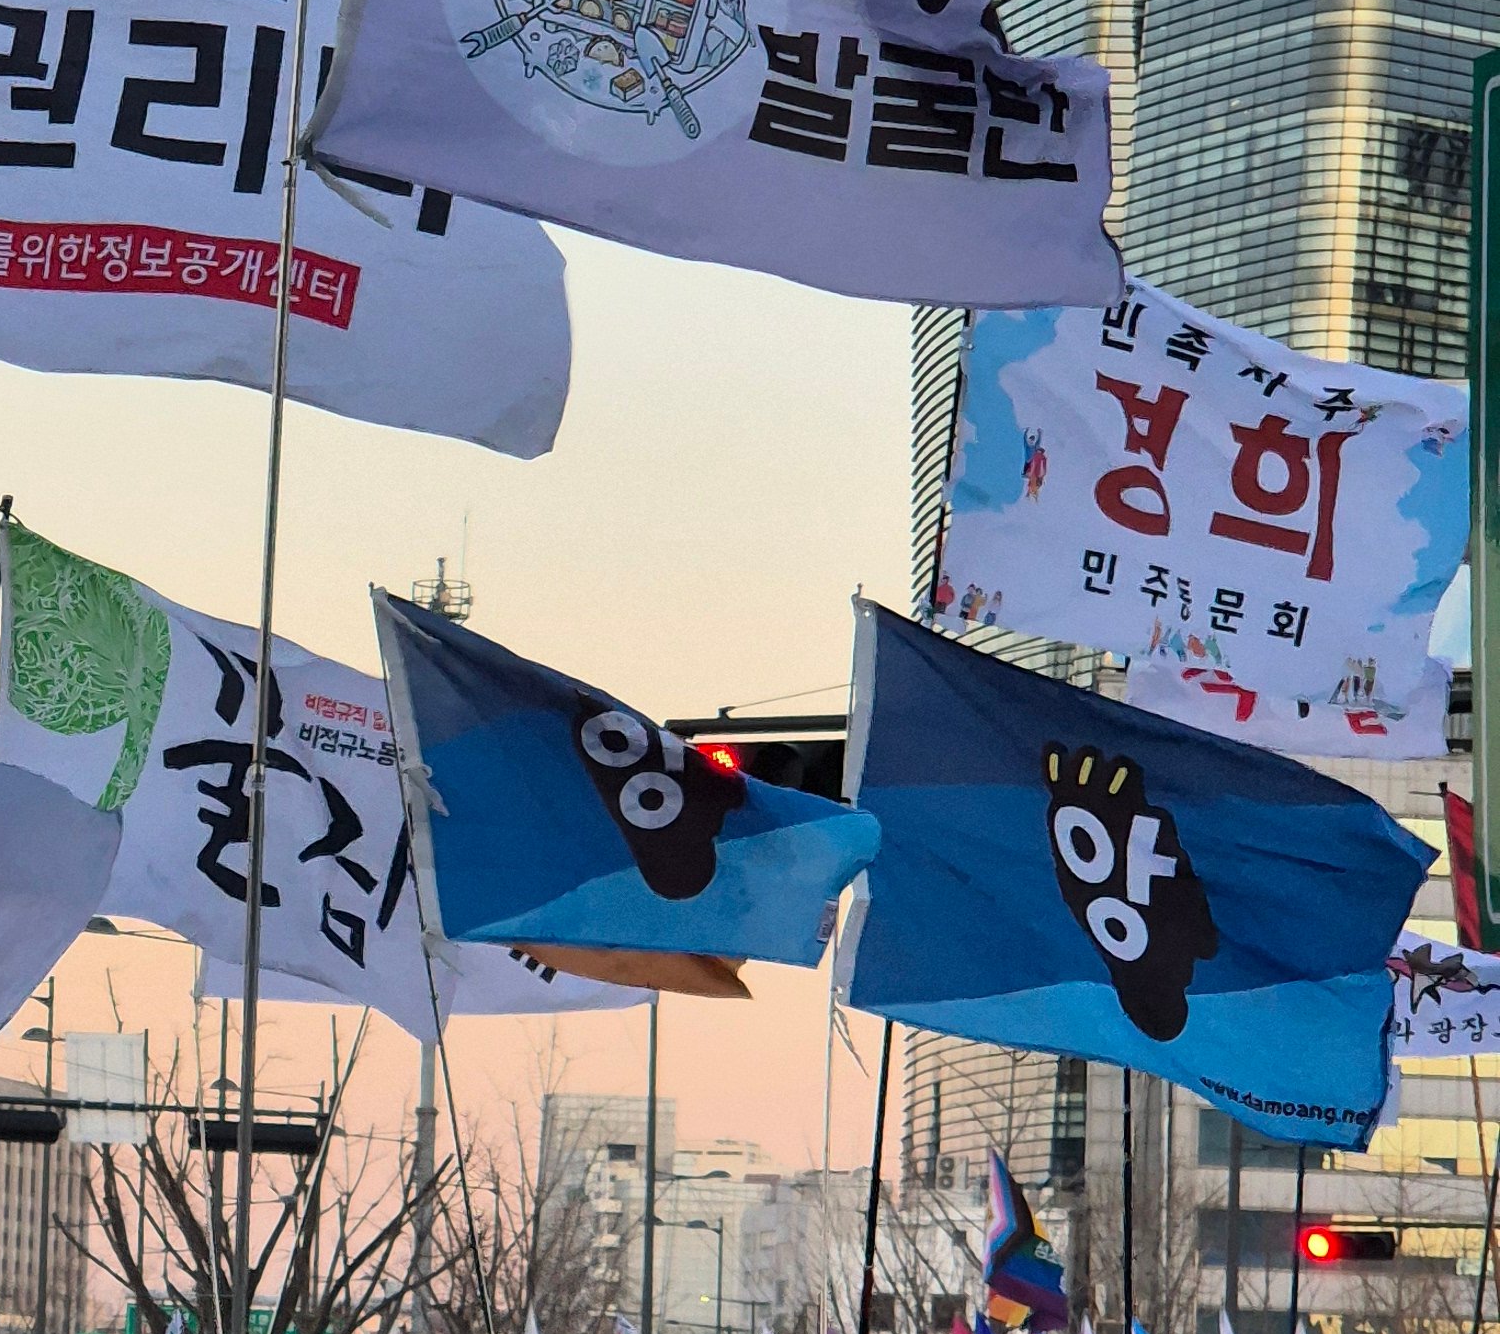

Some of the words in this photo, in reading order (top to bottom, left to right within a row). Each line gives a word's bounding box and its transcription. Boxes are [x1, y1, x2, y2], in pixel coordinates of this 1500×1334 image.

[748, 23, 1078, 184] 발굴단
[298, 722, 398, 767] 비정규노동
[1052, 805, 1177, 962] 앙
